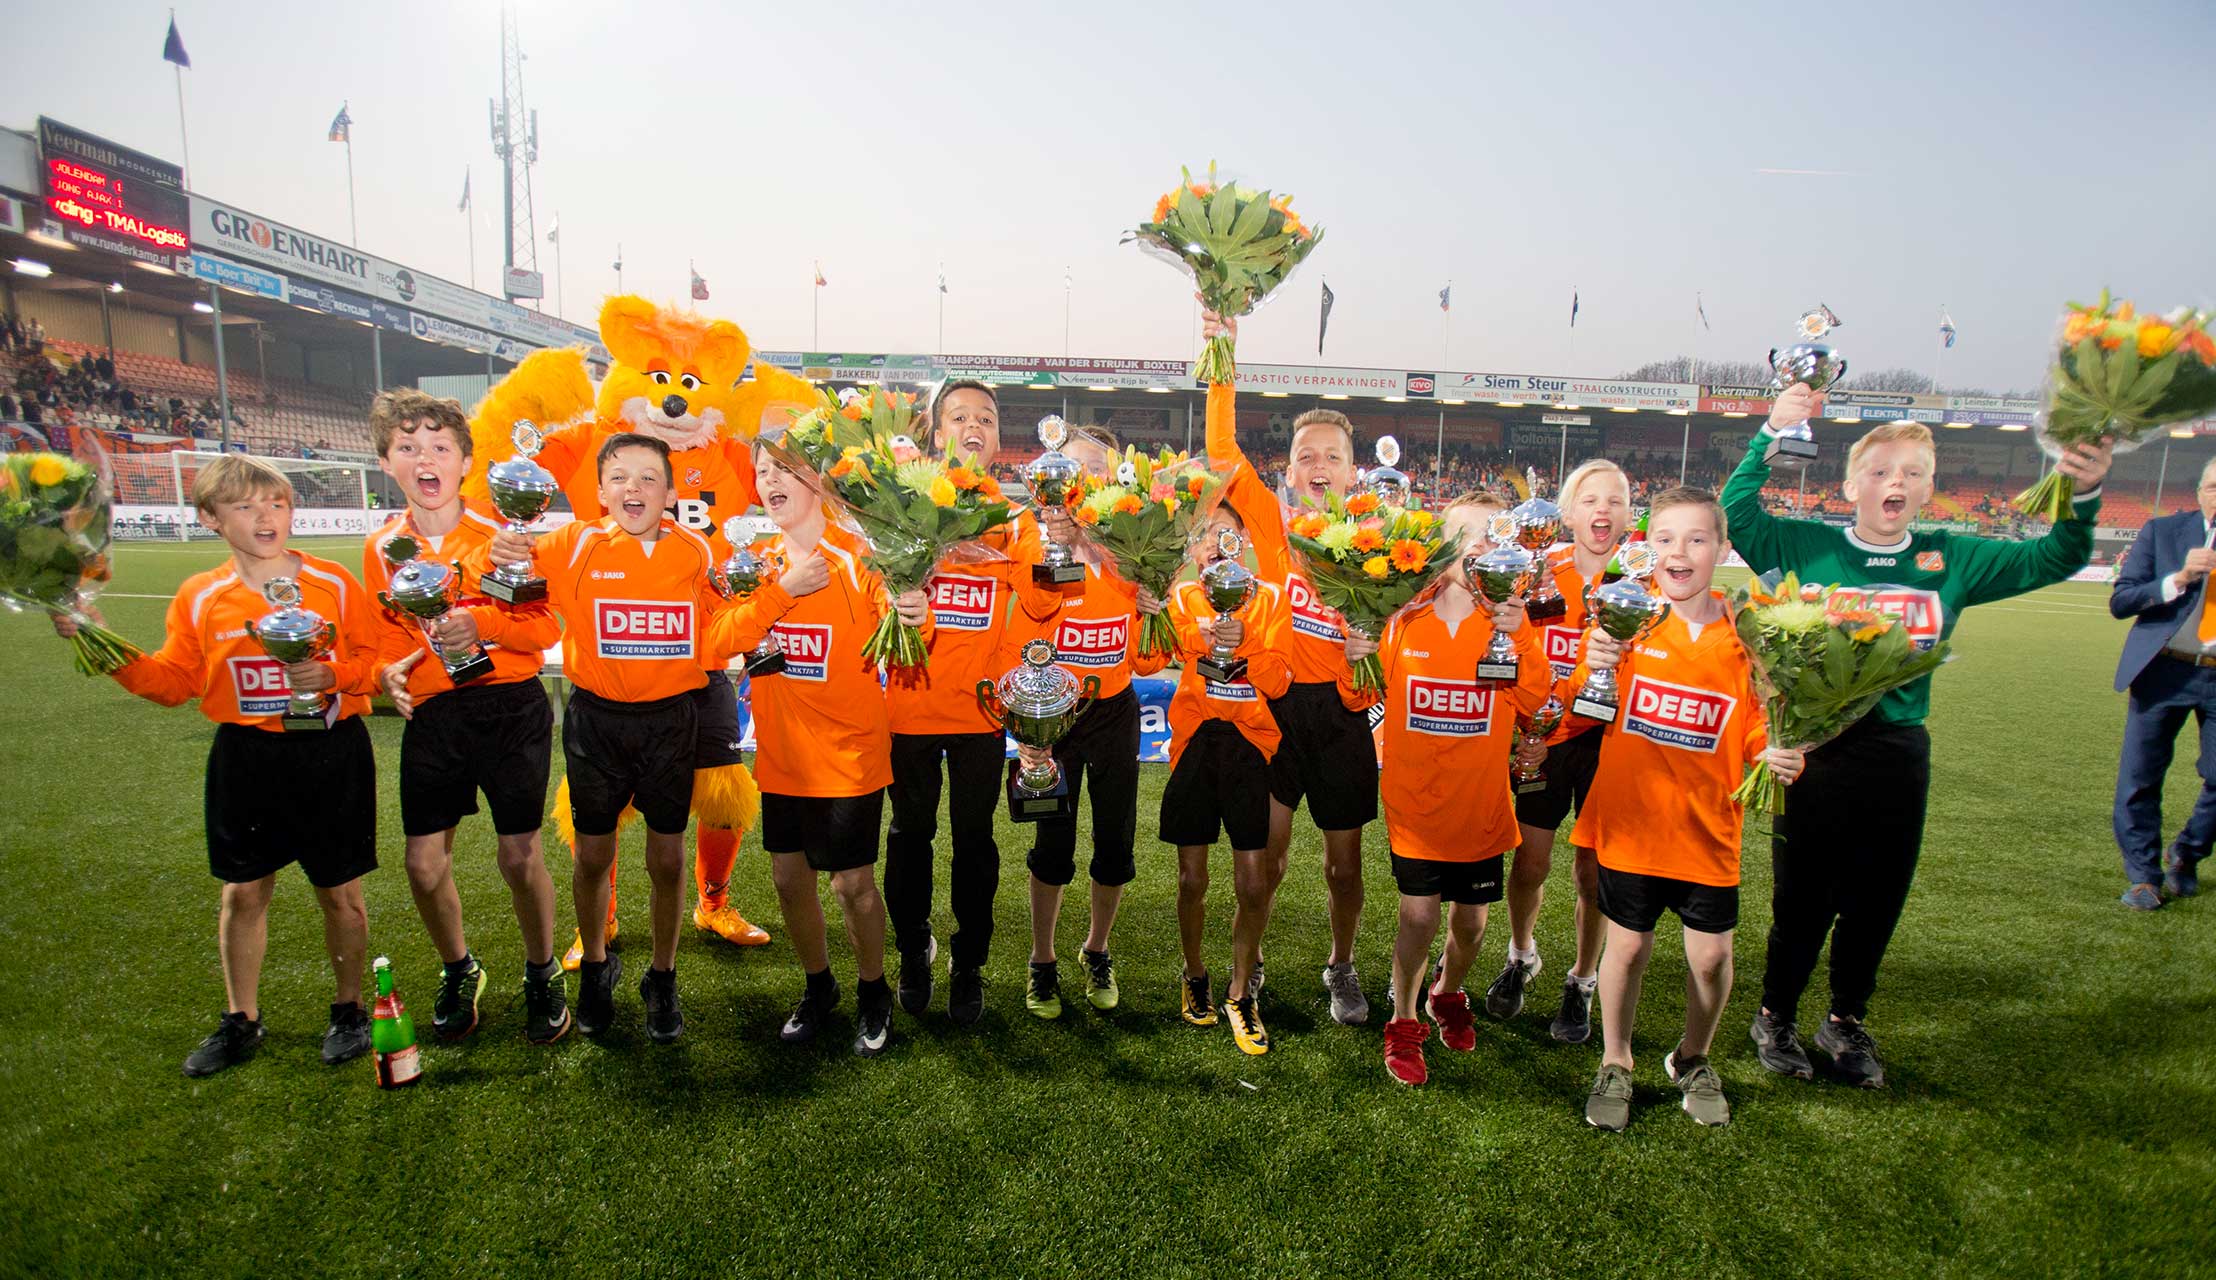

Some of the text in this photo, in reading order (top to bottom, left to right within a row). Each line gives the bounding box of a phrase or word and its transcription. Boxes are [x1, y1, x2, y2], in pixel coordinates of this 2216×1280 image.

[43, 123, 118, 167] Veerman
[86, 189, 113, 205] AJAX
[104, 211, 138, 234] TMA
[70, 231, 171, 266] www.runderkamp.nl
[210, 208, 369, 280] GROENHART
[932, 355, 1186, 371] TRANSPORTBEDRIJF VAN DER STRUIJK BOXTEL
[836, 369, 881, 380] BAKKERIJ
[884, 370, 900, 380] VAN
[1235, 373, 1397, 388] PLASTIC VERPAKKINGEN
[1409, 380, 1432, 390] KIVO
[1484, 375, 1678, 397] Siem Steur STAALCONSTRUCTIES
[1711, 384, 1760, 397] Veerman
[1474, 390, 1499, 399] waste
[1512, 391, 1538, 400] worth
[1599, 396, 1626, 405] waste
[1638, 398, 1664, 407] worth
[1964, 397, 1998, 407] Leinster
[1711, 401, 1737, 411] ING
[1863, 408, 1906, 419] ELEKTRA
[2115, 530, 2138, 541] KWE
[1865, 557, 1897, 567] JAKO
[603, 571, 625, 580] JAKO
[606, 610, 685, 635] DEEN
[936, 615, 982, 625] ERMARKTEN
[1293, 618, 1343, 638] UPERMARKTE
[1062, 625, 1125, 649] DEEN
[610, 645, 681, 655] SUPERMARKTEN
[776, 632, 822, 657] EEN
[1644, 647, 1668, 659] JAKO
[240, 666, 290, 690] DE
[1415, 687, 1487, 713] DEEN
[1636, 688, 1721, 727] DEEN
[1418, 719, 1480, 731] SUPERMARKTEN
